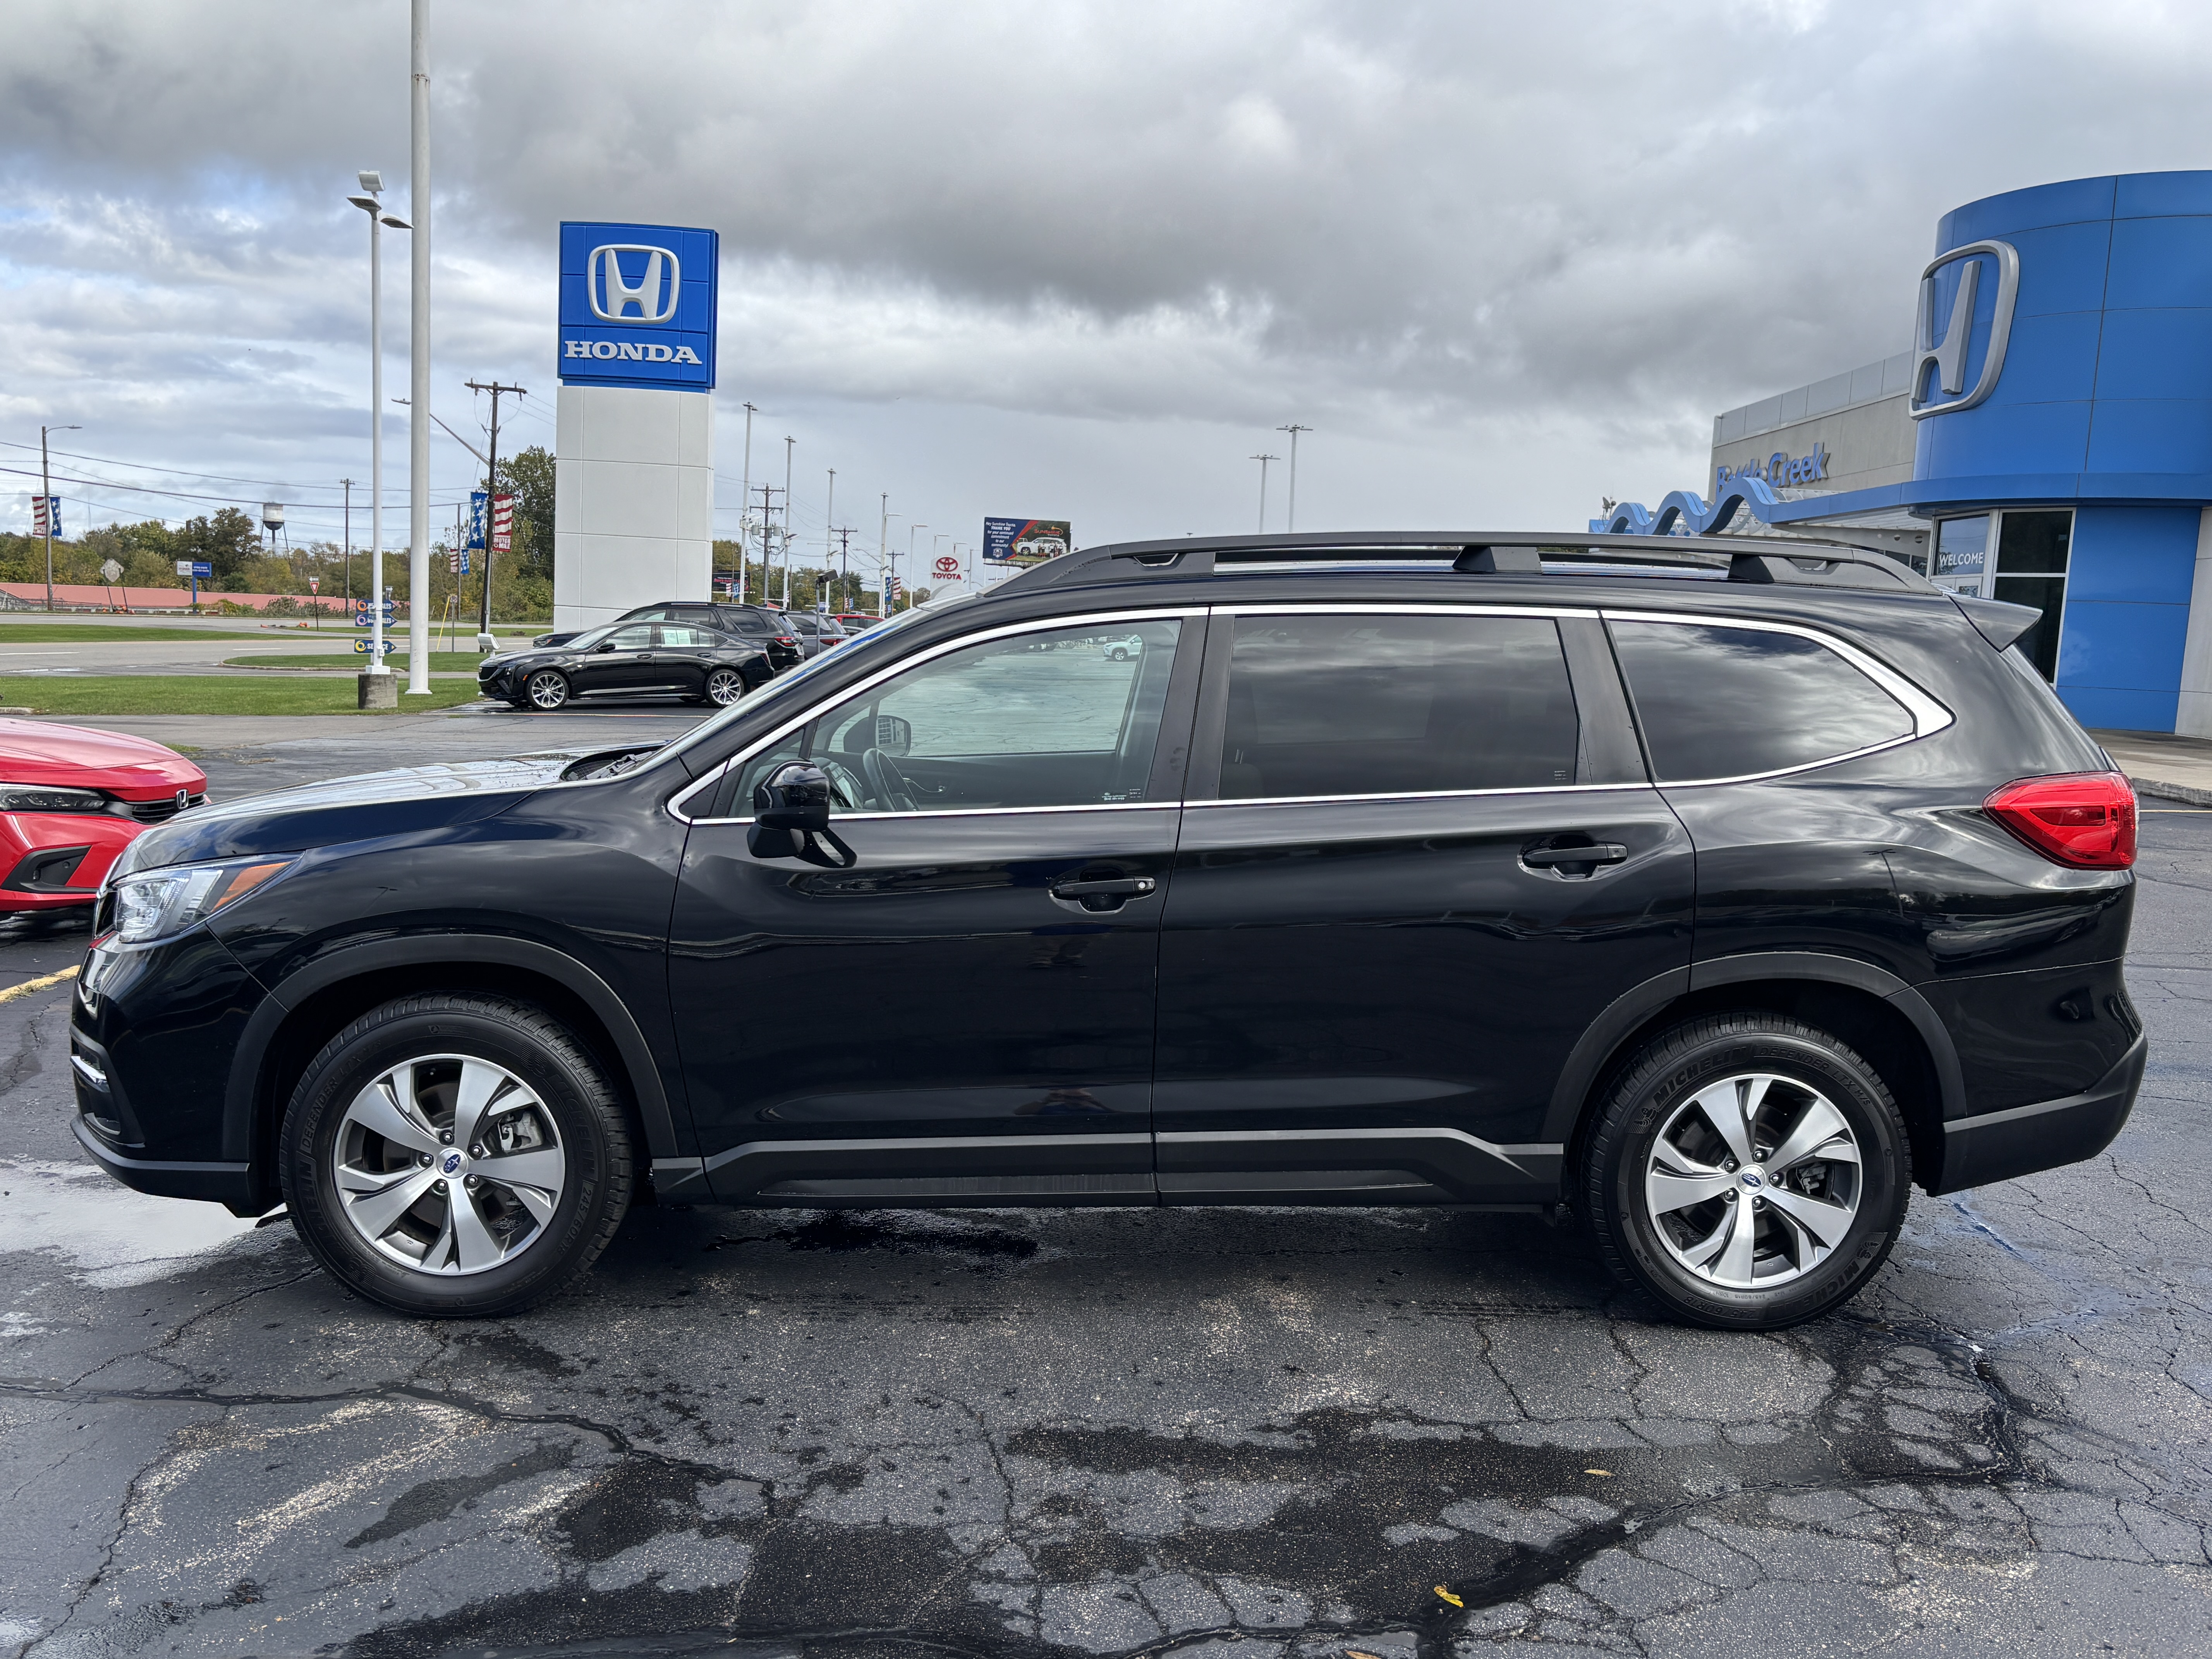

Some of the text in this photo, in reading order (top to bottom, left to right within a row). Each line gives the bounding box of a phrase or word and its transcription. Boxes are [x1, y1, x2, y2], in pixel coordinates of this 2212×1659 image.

[564, 340, 702, 364] HONDA
[1768, 442, 1827, 488] Creek
[1939, 552, 1984, 566] WELCOME
[1653, 1046, 1748, 1107] MICHELIN
[1760, 1047, 1829, 1072] DEFENDER
[1832, 1070, 1856, 1089] LTX
[557, 1186, 592, 1255] 245/60R18
[1683, 1296, 1757, 1318] 245/60R18
